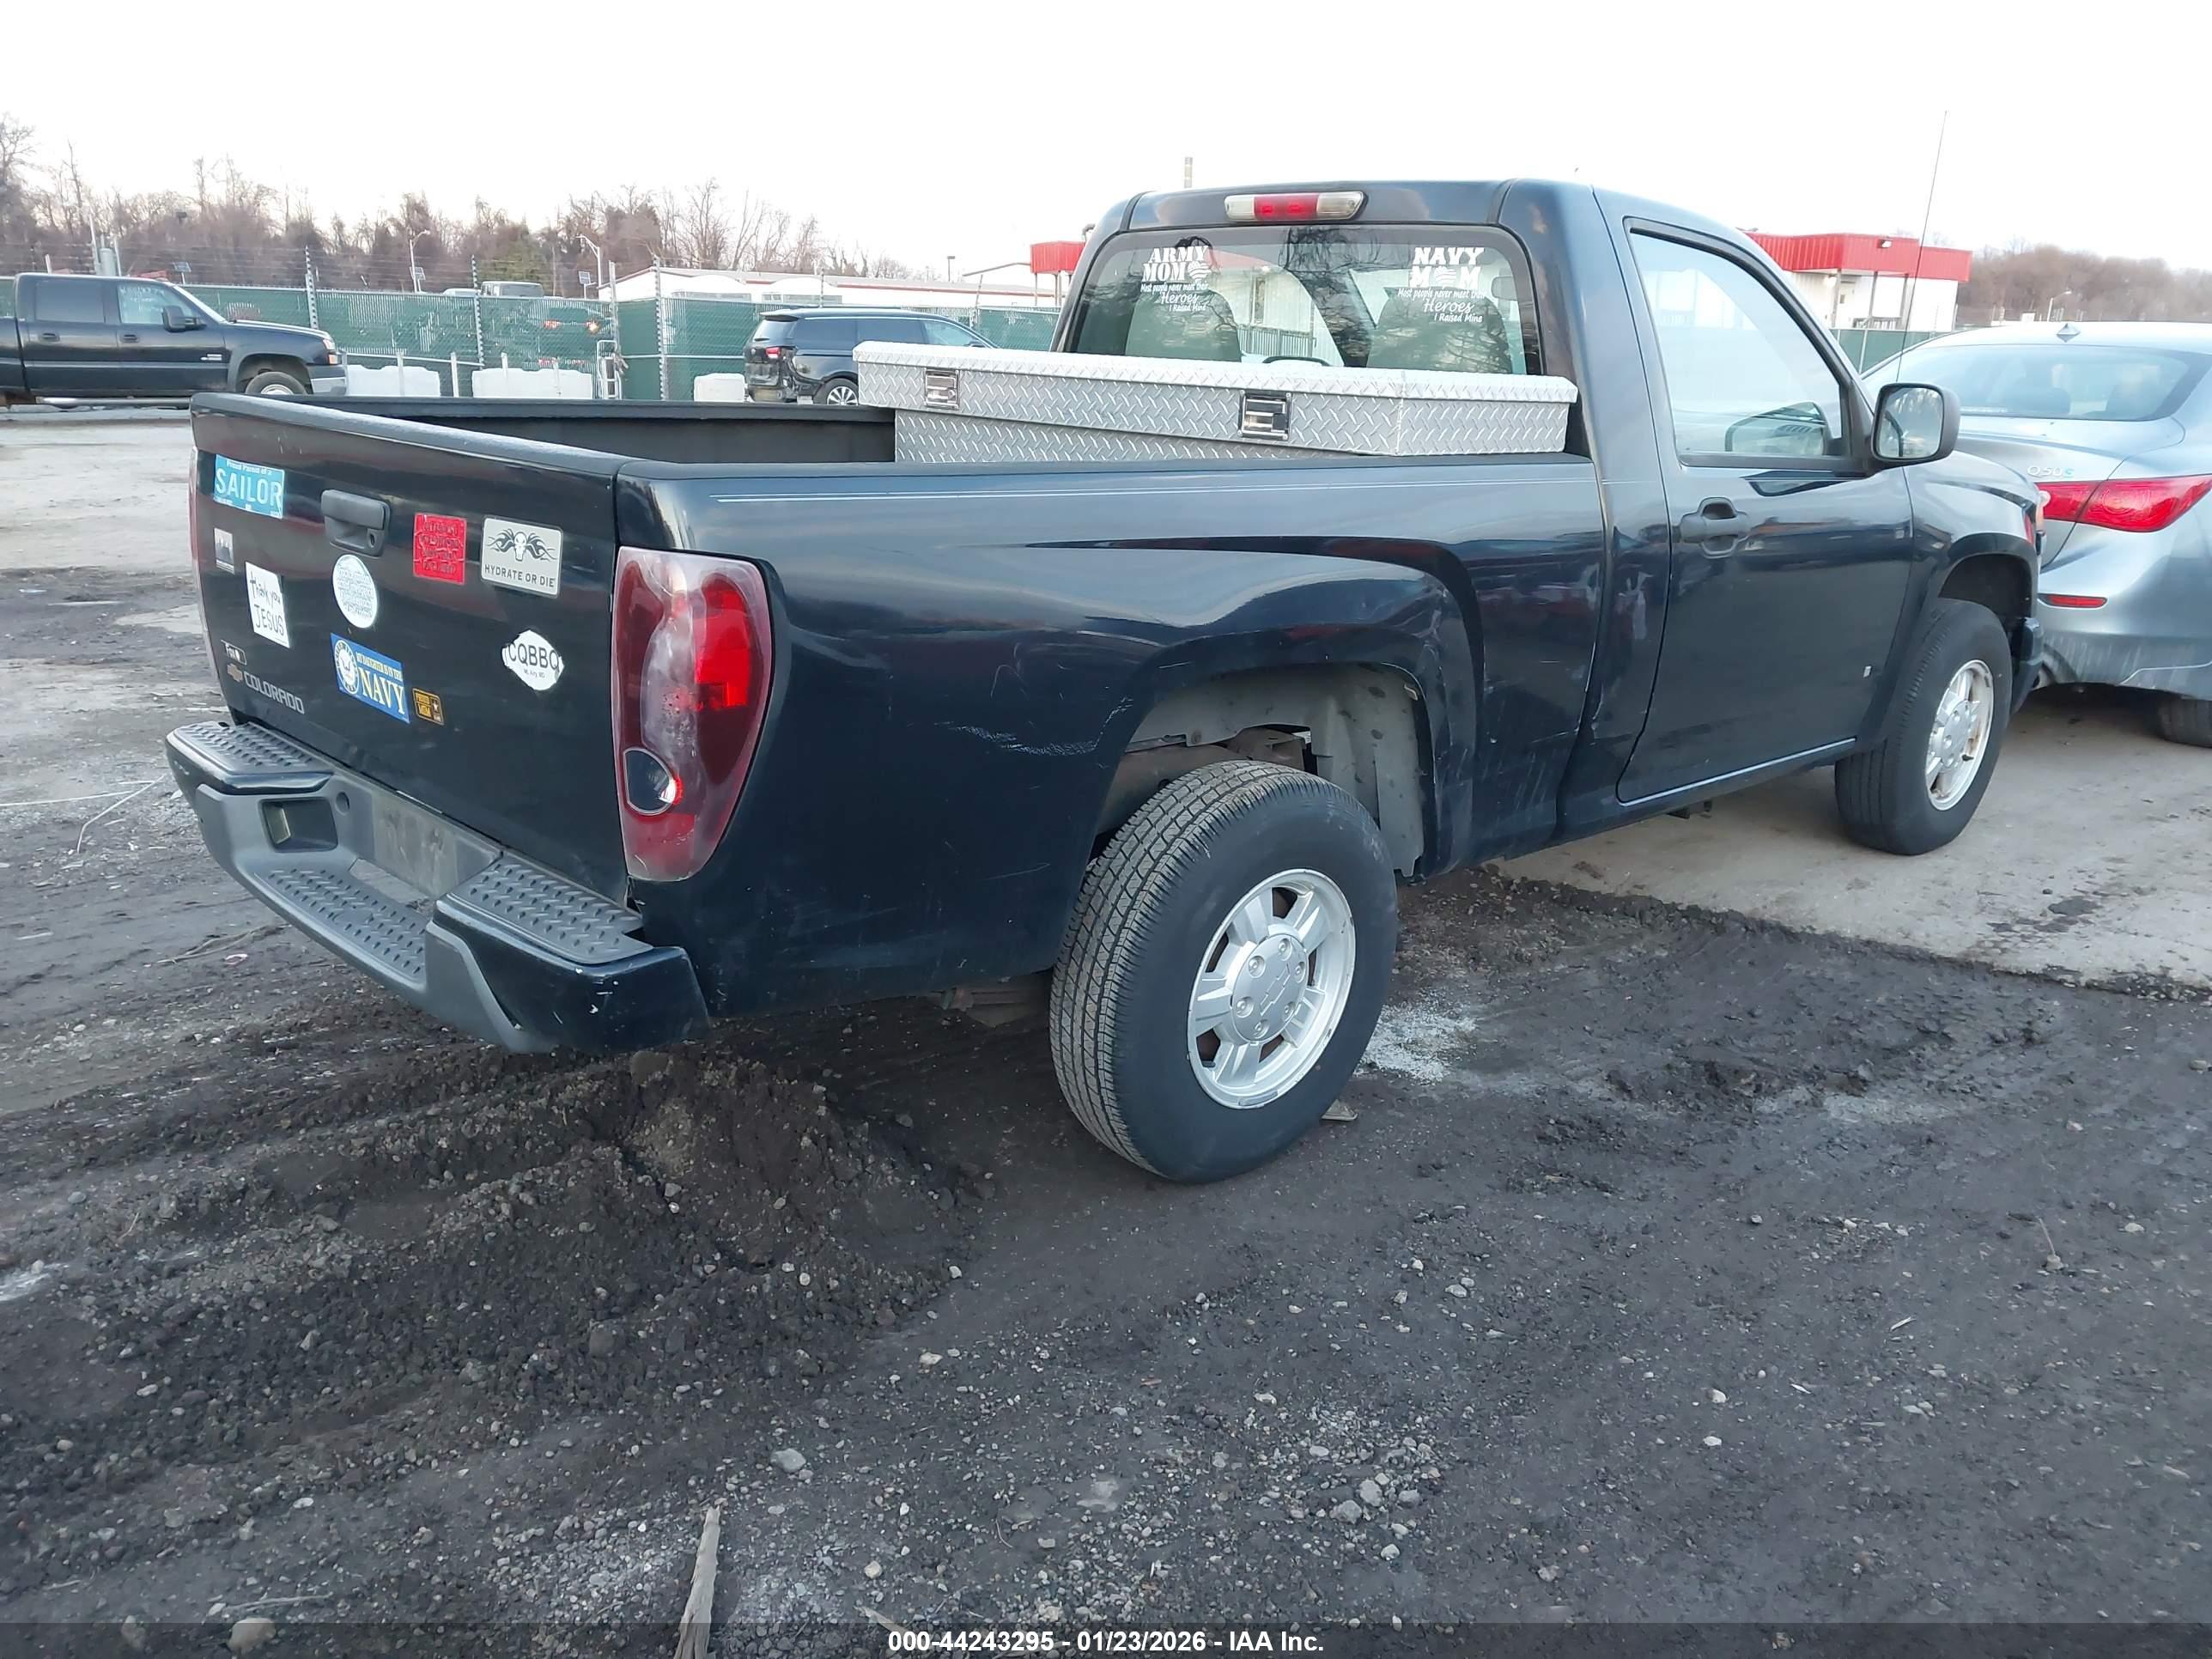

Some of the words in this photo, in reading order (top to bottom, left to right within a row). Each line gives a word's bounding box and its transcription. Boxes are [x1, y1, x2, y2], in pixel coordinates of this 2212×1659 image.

[1148, 246, 1208, 263] ARMY
[1413, 246, 1485, 265] NAVY
[1141, 262, 1186, 282] MOM
[1161, 290, 1200, 305] Heroes
[1397, 288, 1413, 297] Most
[1413, 288, 1433, 301] people
[1424, 299, 1475, 313] Heroes
[1439, 313, 1463, 322] Raised
[1464, 313, 1483, 323] Mine
[216, 468, 283, 509] SAILOR
[484, 564, 523, 580] HYDRATE
[525, 573, 538, 585] OR
[539, 576, 556, 587] DIE
[254, 604, 284, 636] JESUS
[244, 671, 305, 714] COLORADO
[358, 666, 405, 714] NAVY
